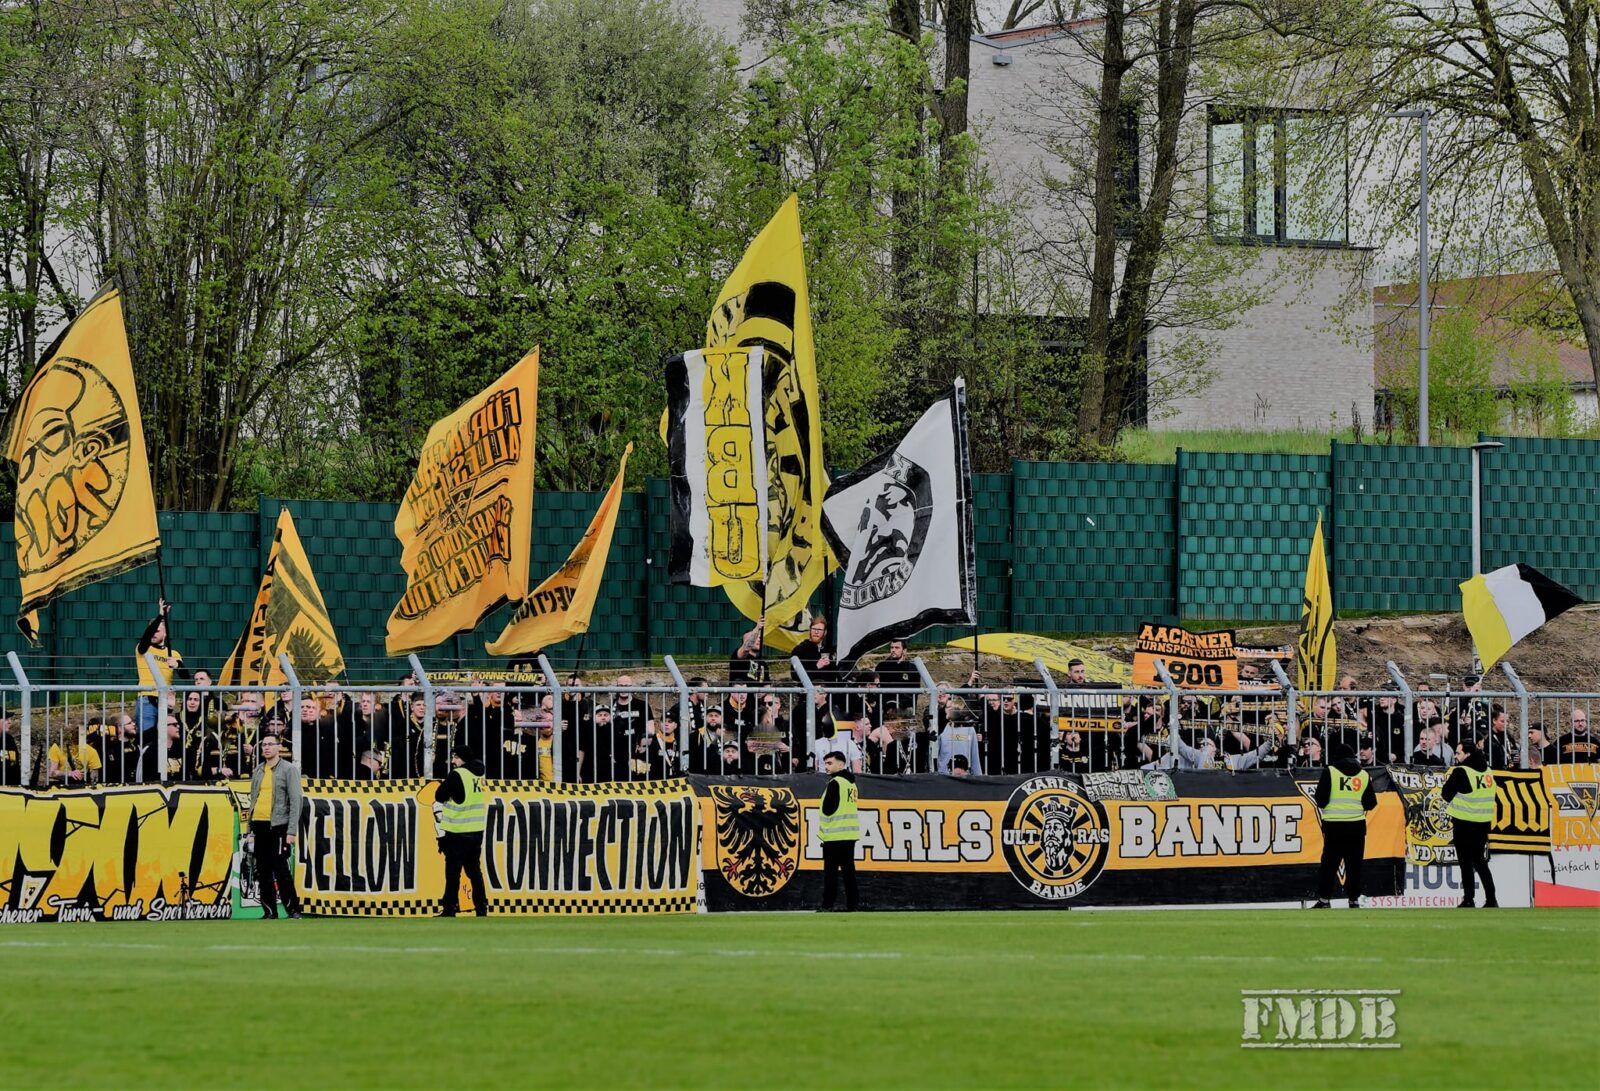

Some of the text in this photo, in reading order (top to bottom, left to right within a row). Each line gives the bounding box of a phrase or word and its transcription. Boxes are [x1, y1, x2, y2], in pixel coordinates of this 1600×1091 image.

[1140, 625, 1233, 649] AACHENER
[1021, 777, 1079, 796] KARLS
[1082, 769, 1144, 786] LEGENDEN
[1340, 776, 1362, 792] K9
[1476, 772, 1493, 789] K9
[1118, 804, 1303, 858] BANDE
[485, 795, 694, 893] CONNECTION
[1029, 878, 1086, 898] BANDE
[114, 899, 142, 920] und
